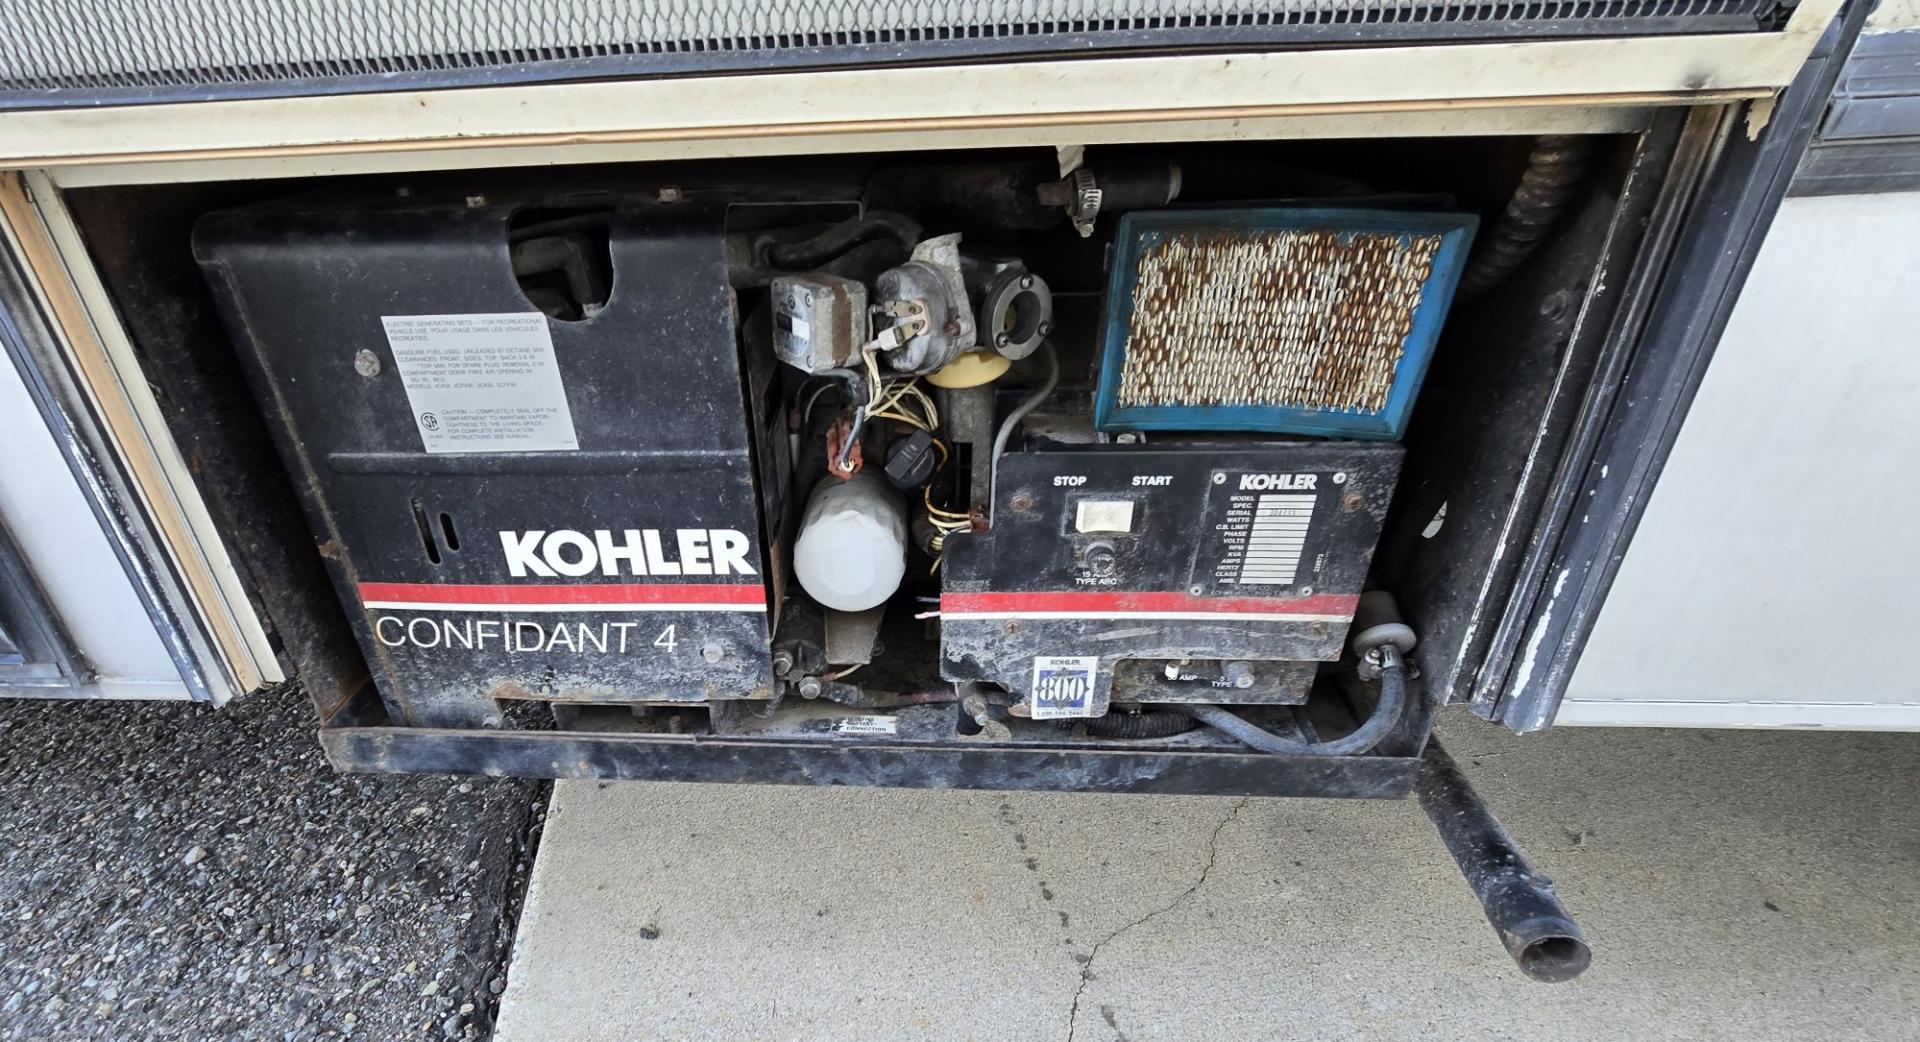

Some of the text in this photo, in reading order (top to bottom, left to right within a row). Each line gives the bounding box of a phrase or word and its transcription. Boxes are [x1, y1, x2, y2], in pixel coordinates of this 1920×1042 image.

[1053, 476, 1087, 486] STOP
[1131, 476, 1173, 486] START
[1239, 474, 1318, 490] KOHLER
[500, 529, 757, 577] KOHLER
[375, 616, 680, 653] CONFIDANT 4
[1039, 677, 1085, 701] 800
